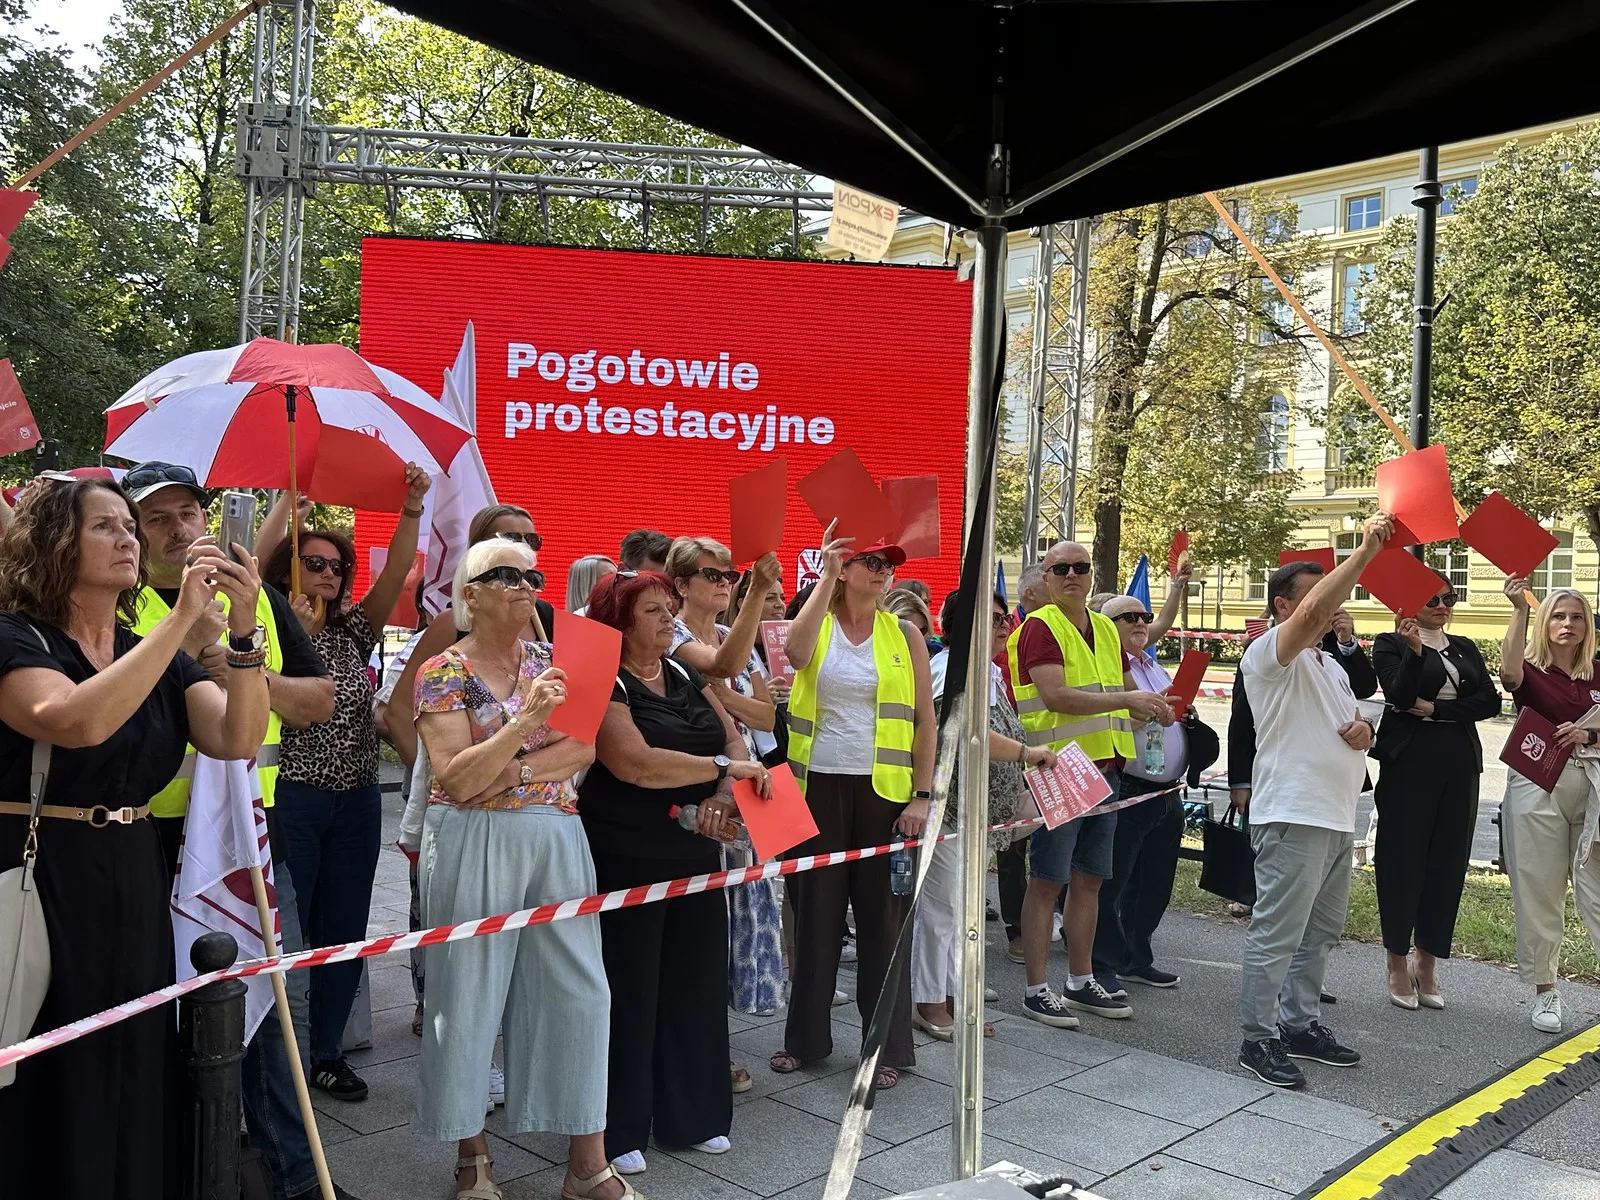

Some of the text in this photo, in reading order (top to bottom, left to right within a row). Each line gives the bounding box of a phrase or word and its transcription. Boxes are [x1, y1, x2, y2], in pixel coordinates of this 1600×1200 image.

[507, 342, 759, 393] Pogotowie
[504, 397, 835, 452] protestacyjne
[1061, 753, 1090, 792] DLA RZĄDU!
[1066, 748, 1088, 776] KARTKA
[1071, 745, 1099, 781] CZERWONA
[1030, 769, 1056, 811] OBIECAŁEŚ!
